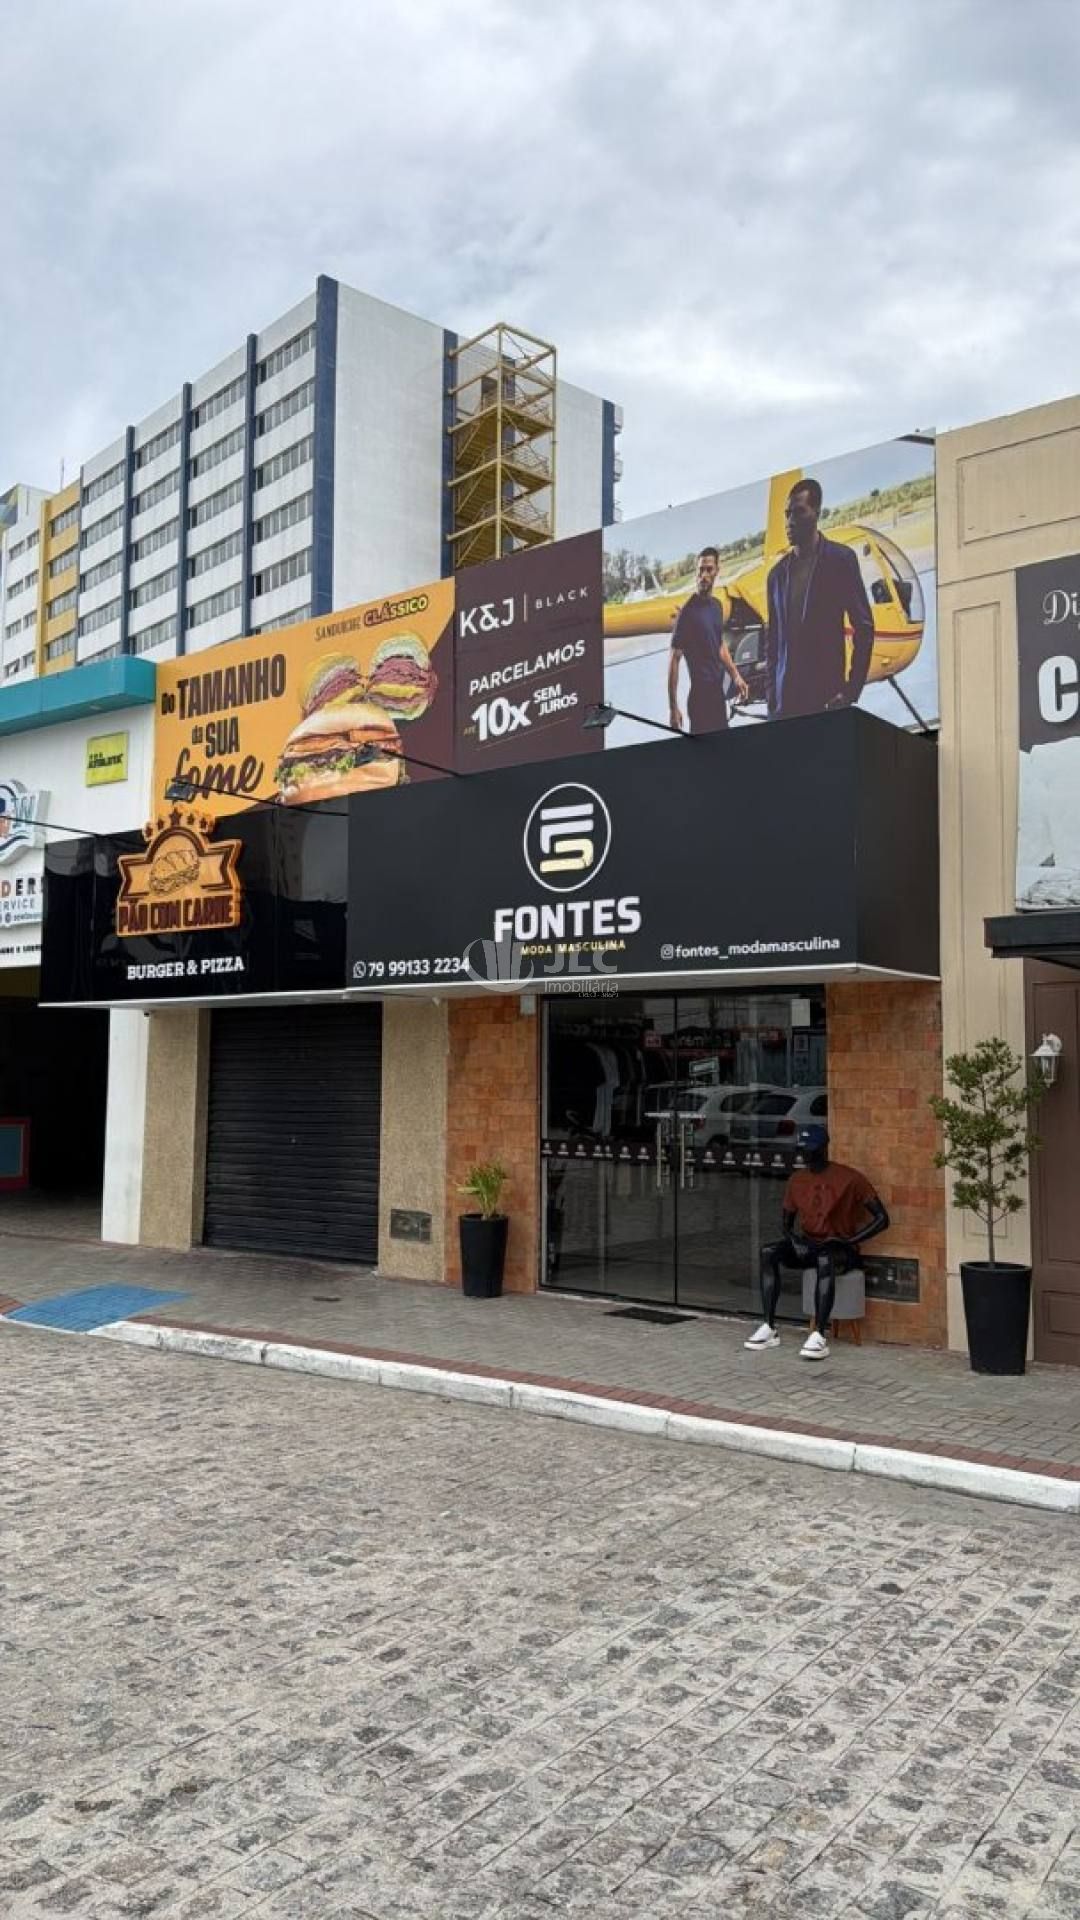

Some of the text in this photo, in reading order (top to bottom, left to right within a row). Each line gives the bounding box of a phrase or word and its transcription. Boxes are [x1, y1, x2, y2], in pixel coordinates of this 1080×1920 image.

[364, 594, 428, 627] CLÁSSICO
[460, 587, 588, 637] K&J BLACK
[468, 640, 585, 697] PARCELAMOS
[177, 654, 286, 720] TAMANHO
[533, 684, 562, 704] SEM
[471, 697, 532, 741] 10x
[538, 693, 578, 717] JUROS
[205, 717, 240, 759] SUA
[494, 896, 642, 943] FONTES
[521, 939, 626, 956] MODA MASCULINA
[675, 936, 840, 959] fontes_modamasculina
[127, 956, 245, 981] BURGER & PIZZA
[368, 957, 470, 977] 79 99133 2234
